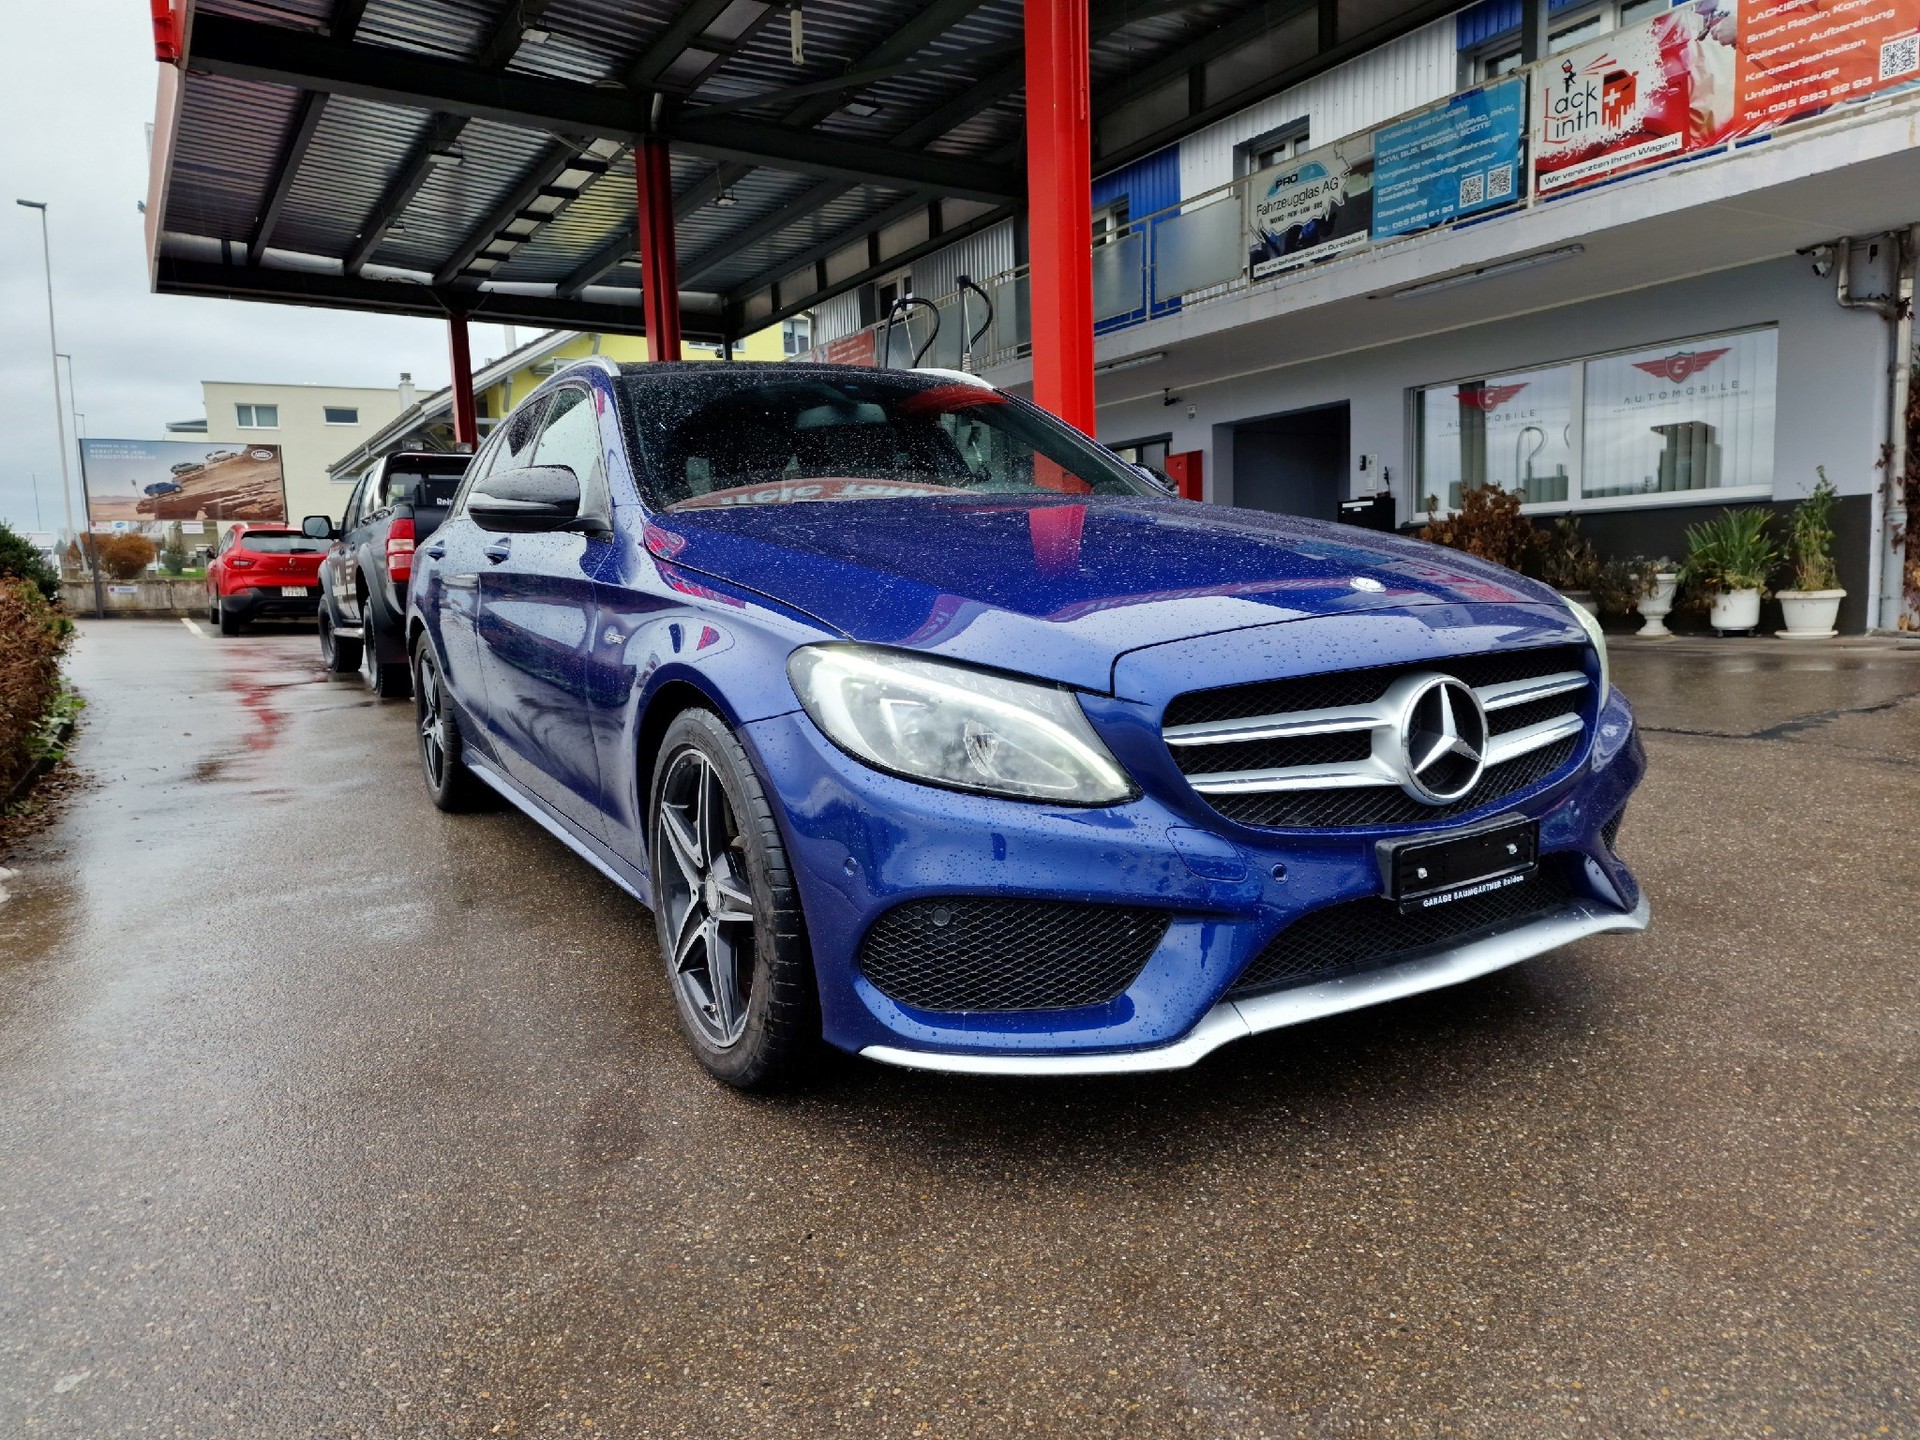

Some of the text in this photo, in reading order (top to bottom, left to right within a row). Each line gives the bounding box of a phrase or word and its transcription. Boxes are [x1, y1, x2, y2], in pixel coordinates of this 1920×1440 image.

[1746, 25, 1787, 43] Smart
[1787, 11, 1830, 29] Repair,
[1746, 41, 1795, 62] Polieren
[1808, 8, 1895, 42] Aufbereitung
[1745, 38, 1866, 82] Karosseriearbeiten
[1544, 80, 1598, 119] Lack
[1744, 67, 1840, 101] Unfallfahrzeuge
[1768, 99, 1797, 114] 055
[1799, 91, 1828, 105] 283
[1830, 83, 1850, 95] 22
[1852, 76, 1873, 89] 93
[1379, 105, 1469, 143] UNSERE LEISTUNGEN
[1460, 120, 1492, 138] BOOTE
[1543, 110, 1598, 144] Linth
[1378, 131, 1509, 180] Verglasung von Spezialfahrzeugen
[1544, 137, 1678, 185] Wir verarzten Ihren Wagen!
[1256, 176, 1339, 217] Fahrzeugglas AG
[1275, 173, 1298, 189] PRO
[1377, 198, 1428, 218] Glasreinigung
[1304, 250, 1315, 259] Sie
[1623, 380, 1740, 405] AUTOMOBILE
[1422, 893, 1452, 907] GARAGE
